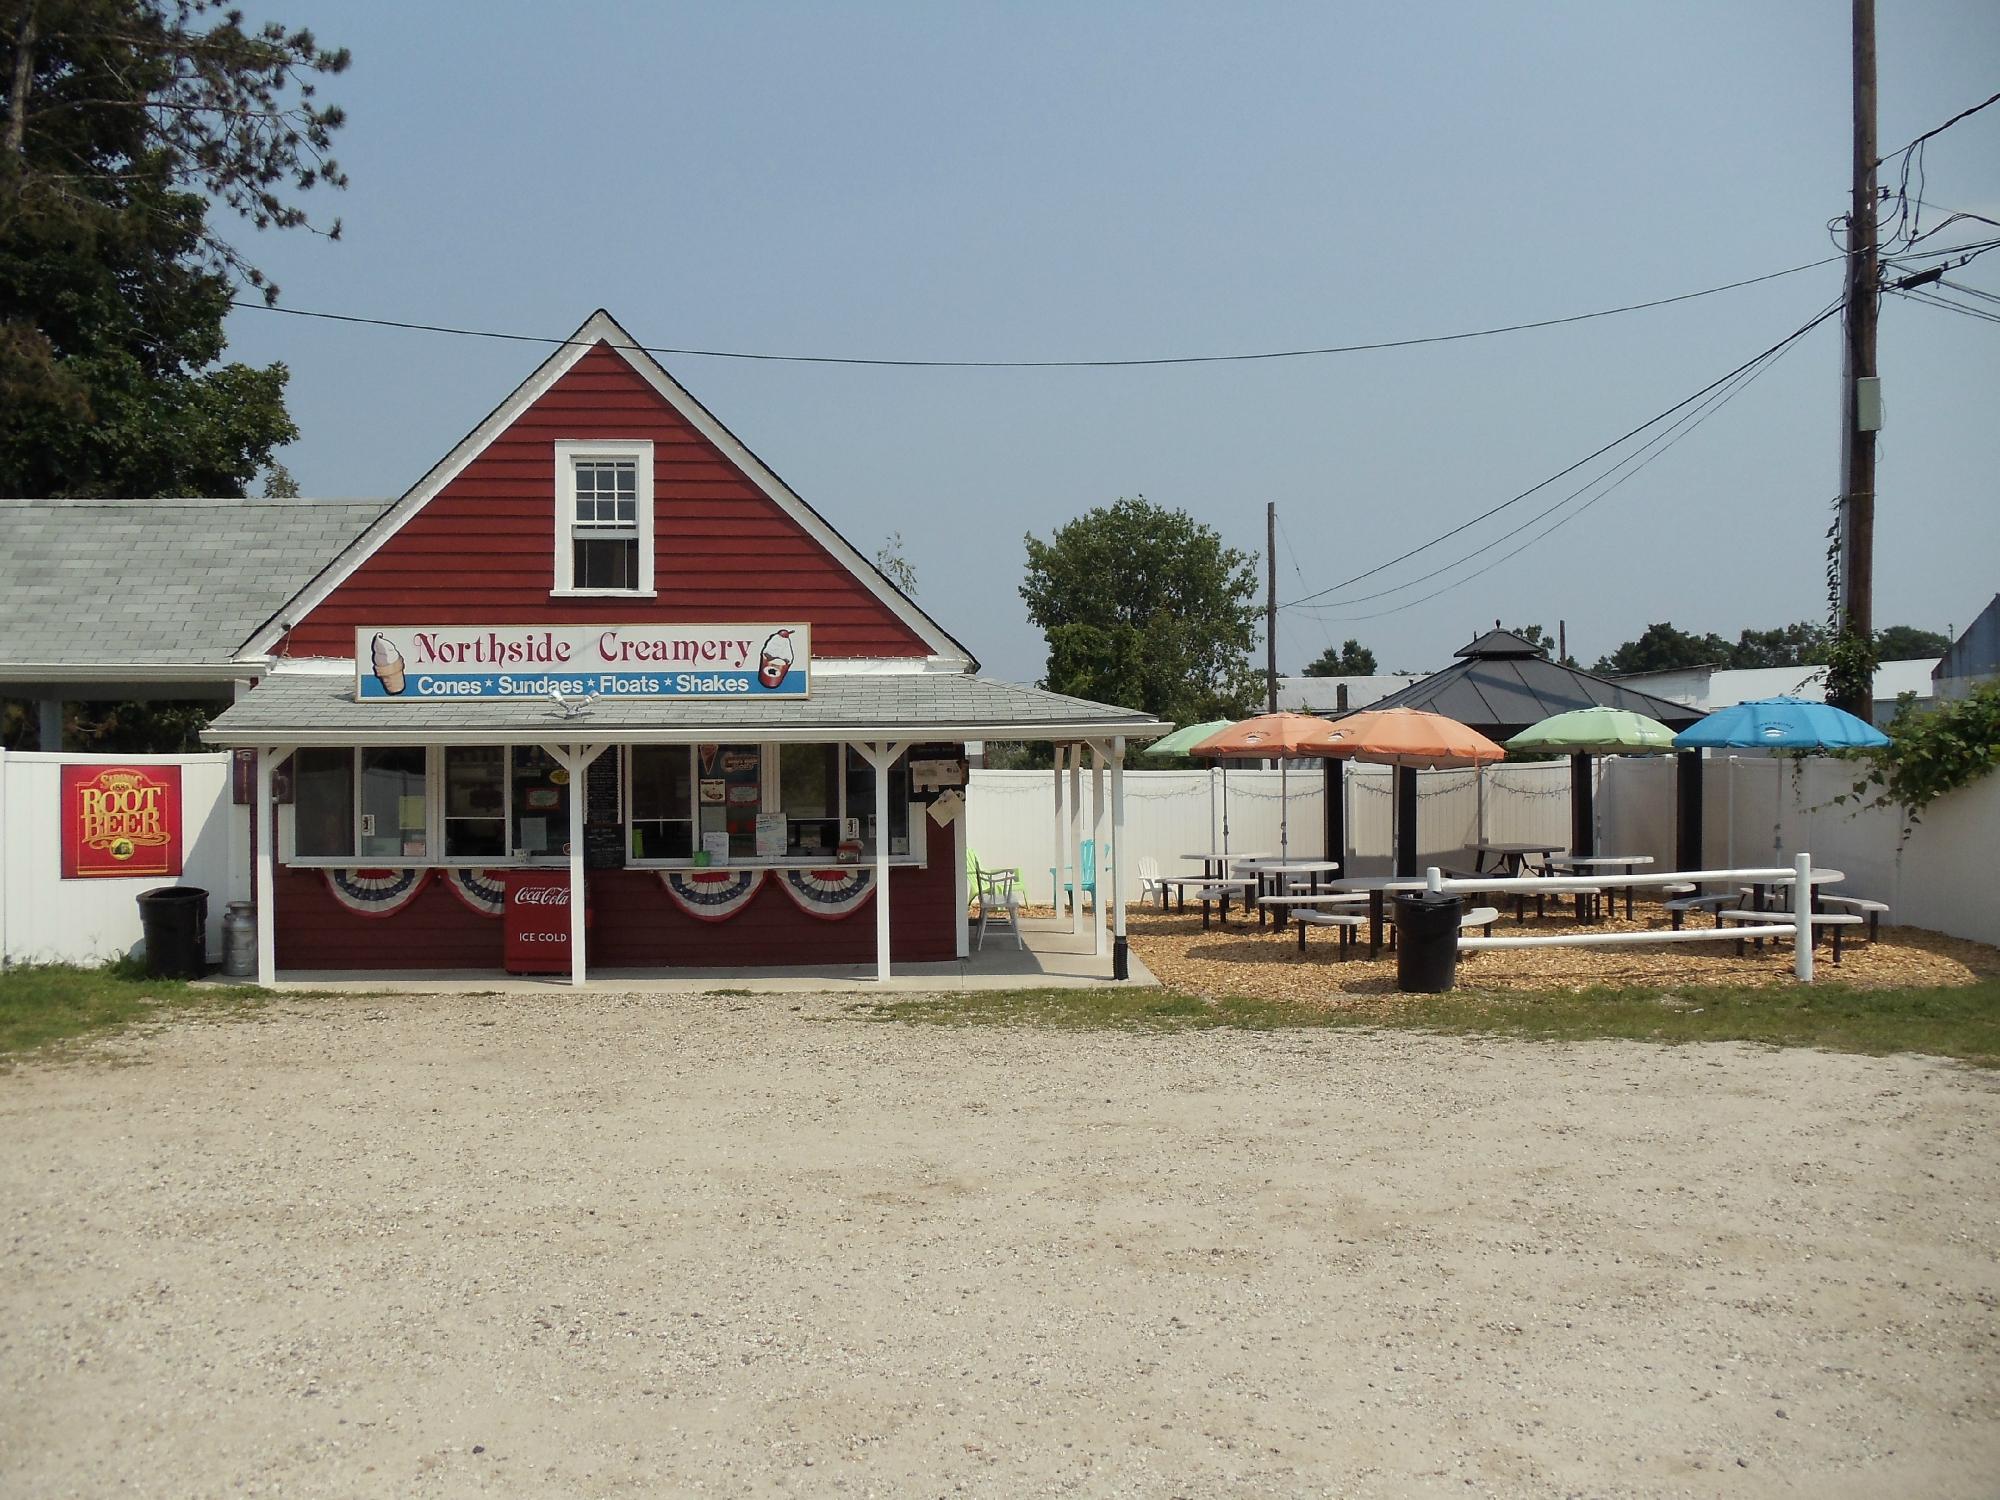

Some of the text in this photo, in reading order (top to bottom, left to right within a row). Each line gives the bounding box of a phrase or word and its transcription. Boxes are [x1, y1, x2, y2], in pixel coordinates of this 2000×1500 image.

[413, 631, 753, 669] Northside Creamery
[417, 674, 749, 695] Cones Sundaes Floats Shakes
[80, 787, 161, 818] ROOT
[81, 807, 162, 843] BEER
[519, 932, 567, 942] ICE COLD
